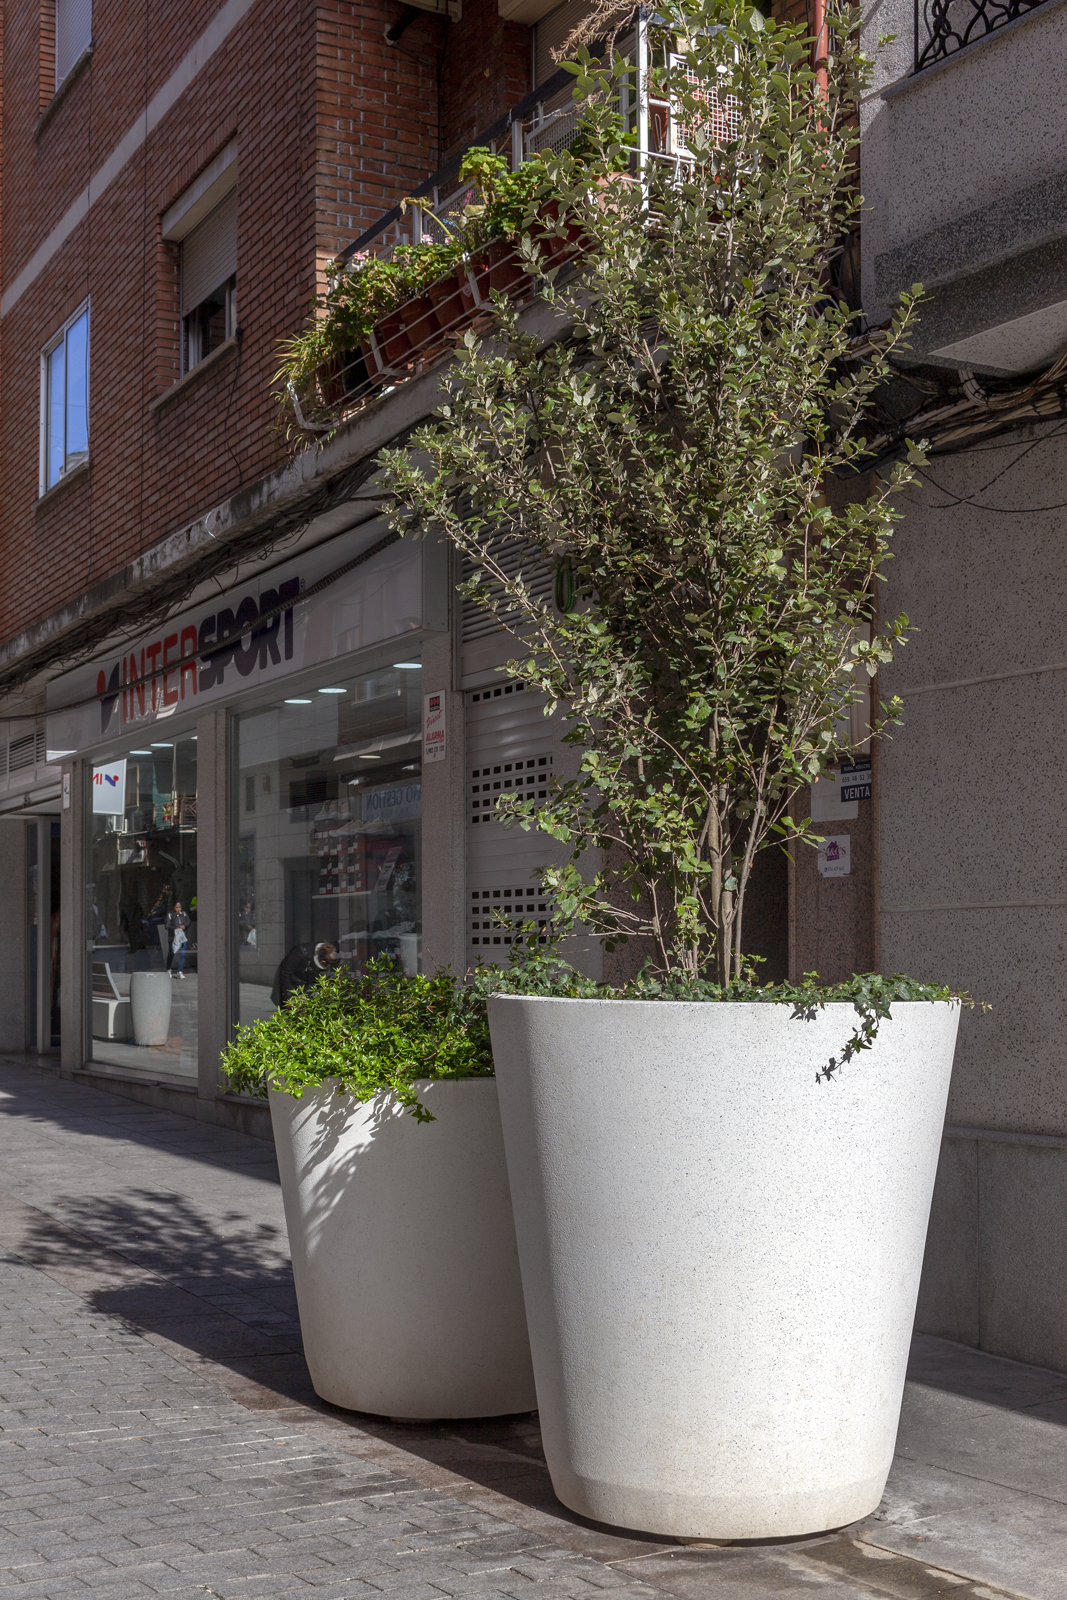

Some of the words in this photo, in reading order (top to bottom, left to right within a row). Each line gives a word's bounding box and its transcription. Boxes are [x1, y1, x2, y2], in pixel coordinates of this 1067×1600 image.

[122, 576, 300, 723] INTERSPORT
[426, 729, 445, 742] ALARMA
[844, 785, 870, 799] VENTA
